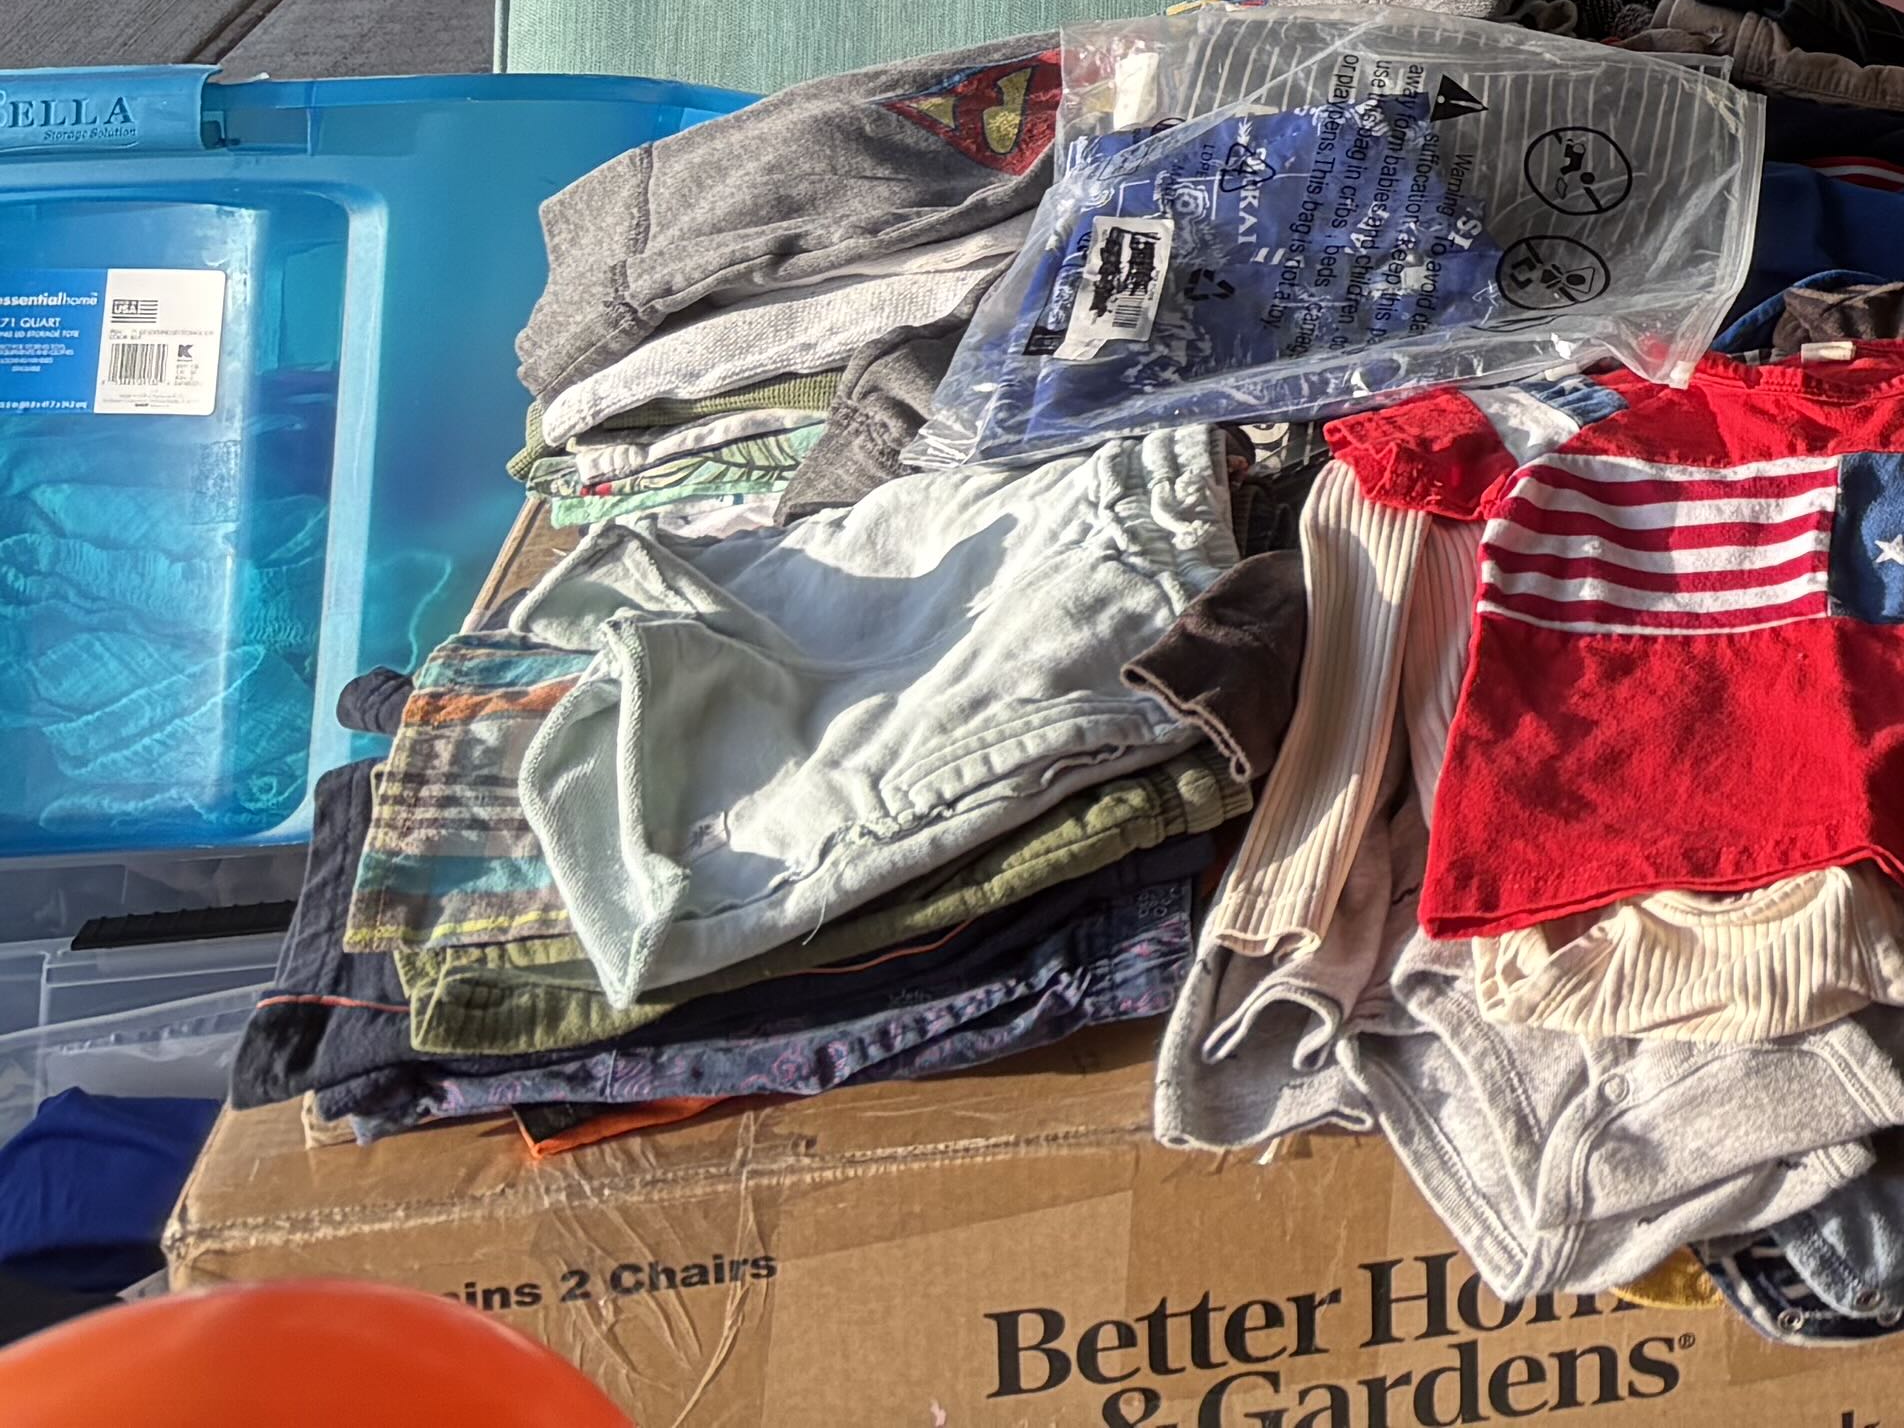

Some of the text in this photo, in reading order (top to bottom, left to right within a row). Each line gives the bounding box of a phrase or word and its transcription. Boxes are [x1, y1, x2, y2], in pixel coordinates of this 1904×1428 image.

[42, 126, 137, 141] Storage Solution
[1415, 260, 1443, 312] avoid
[0, 317, 62, 328] 71 QUART
[113, 303, 139, 315] USA
[560, 1250, 779, 1304] 2 Chairs
[983, 1286, 1343, 1401] Better
